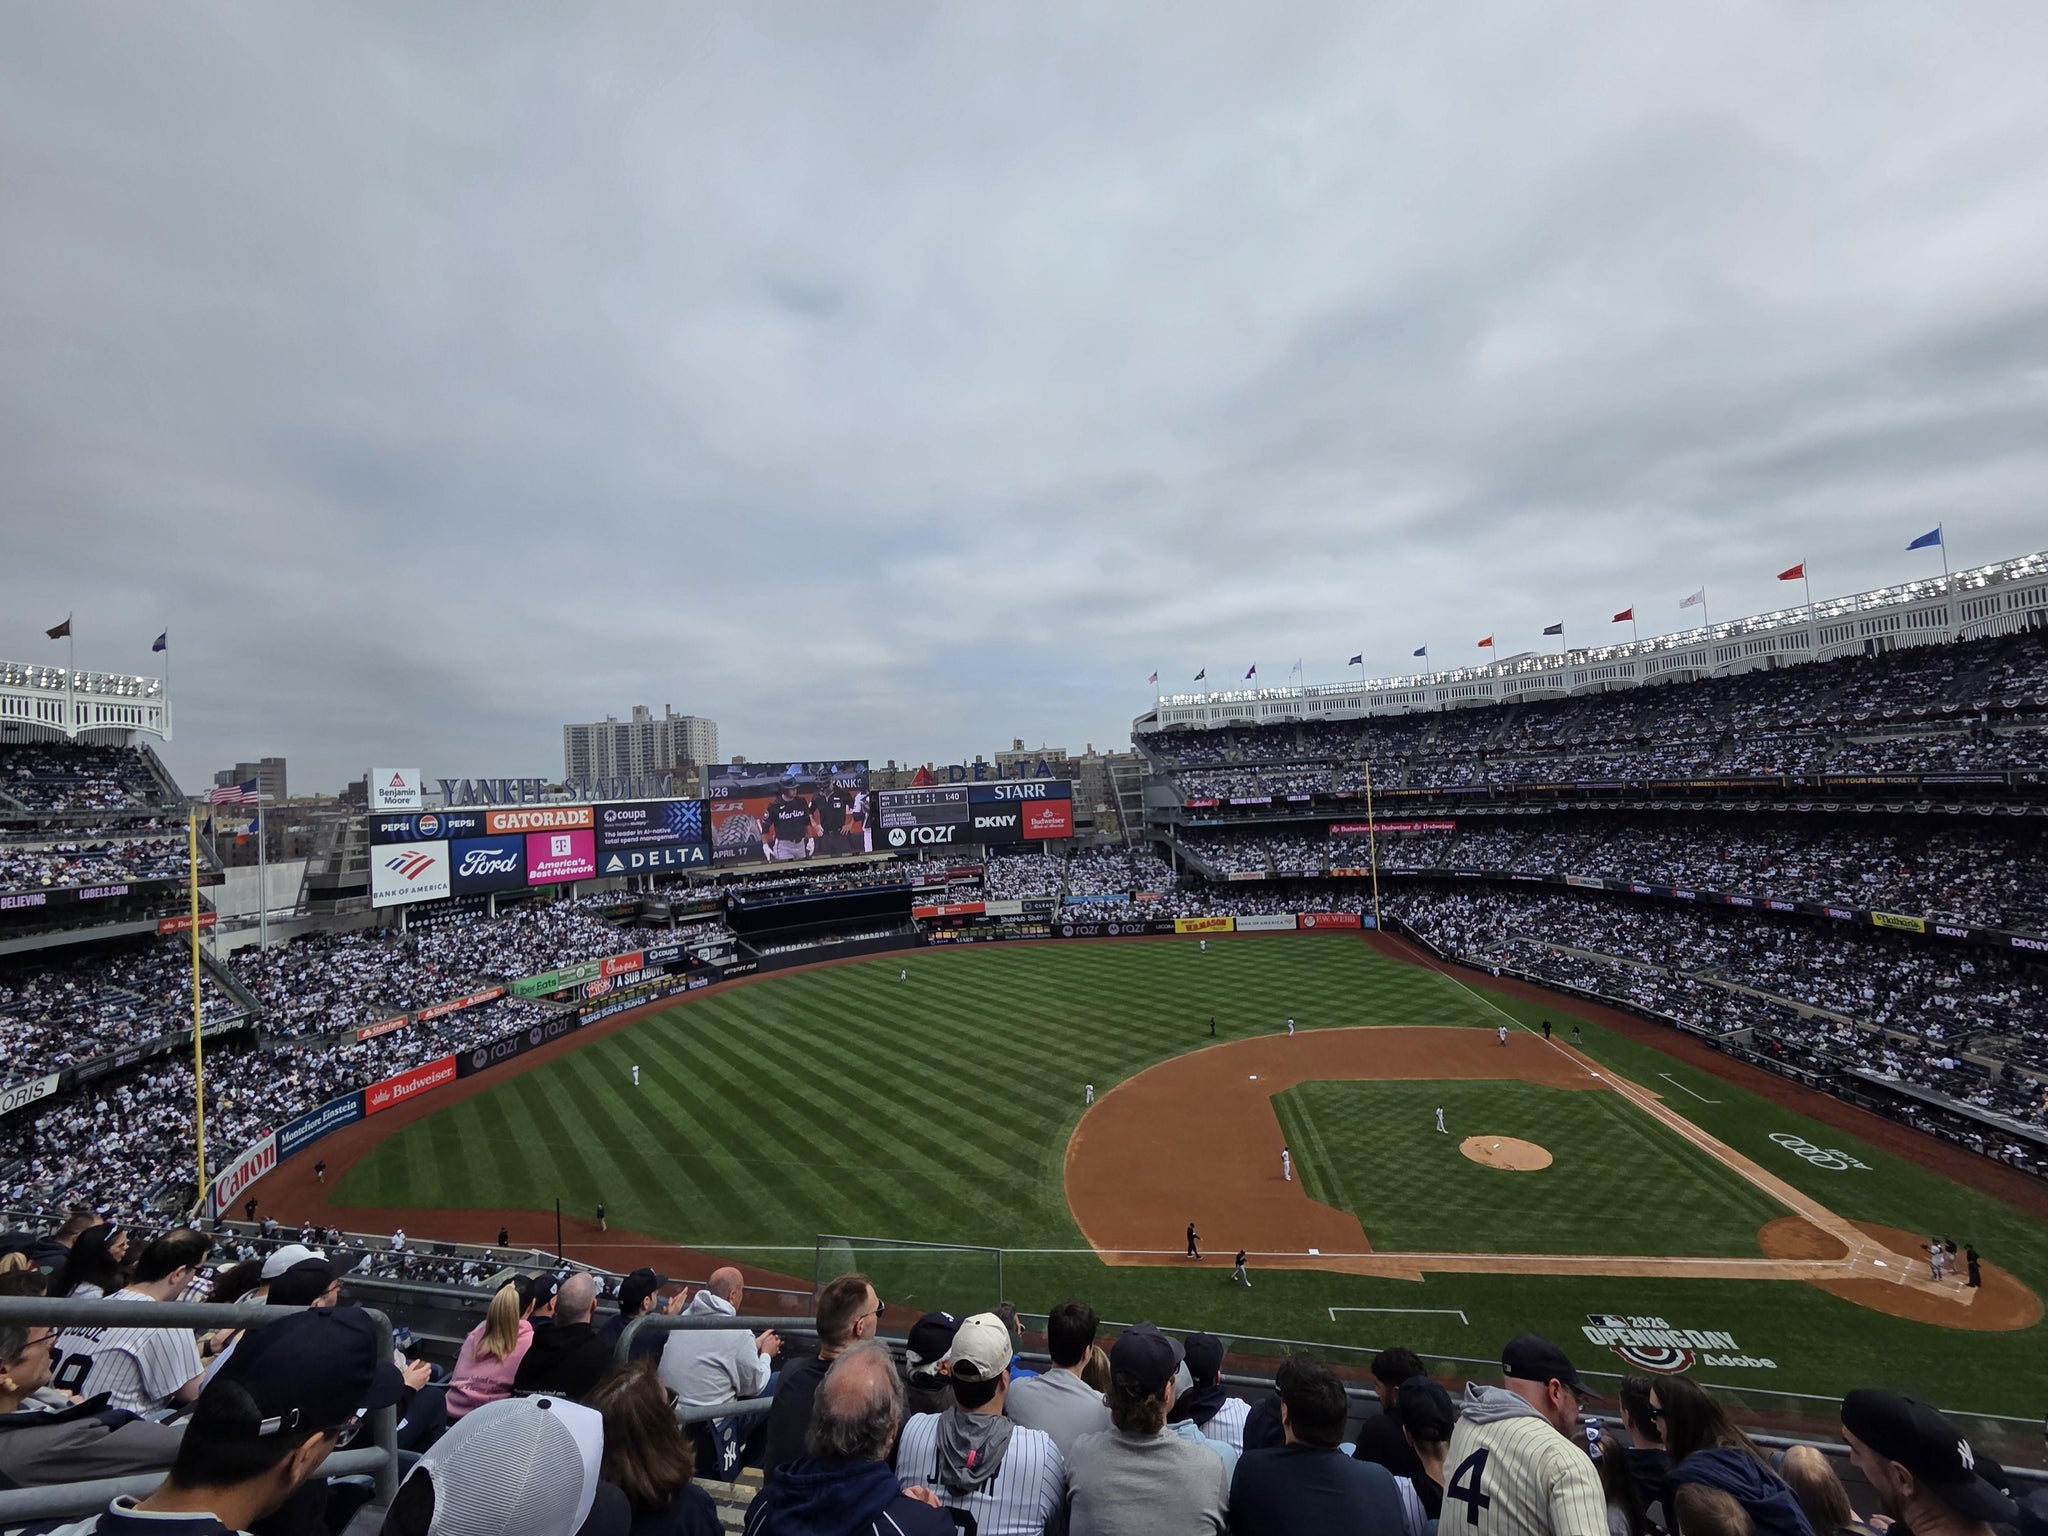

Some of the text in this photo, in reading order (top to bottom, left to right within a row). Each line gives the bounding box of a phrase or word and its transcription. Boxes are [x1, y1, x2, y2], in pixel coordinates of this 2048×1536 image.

[1746, 737, 1815, 748] ASPEN VODKA
[949, 759, 1053, 783] DELTA
[379, 788, 416, 799] Benjamin
[563, 775, 675, 803] STADIUM
[945, 792, 960, 801] 1:40
[994, 784, 1046, 800] STARR
[493, 809, 589, 830] GATORADE
[618, 810, 646, 821] coupa
[974, 815, 1016, 829] DKNY
[1031, 817, 1065, 826] Budweiser
[381, 823, 410, 832] PEPSI
[448, 819, 475, 828] PEPSI
[640, 833, 680, 843] management
[910, 826, 955, 844] razr
[631, 847, 704, 868] DELTA
[713, 847, 748, 859] APRIL 17
[459, 849, 518, 877] Ford
[537, 857, 586, 871] America's
[529, 865, 594, 879] Best Network
[79, 885, 128, 900] LOBELS.COM
[373, 890, 397, 899] BANK
[411, 883, 448, 894] AMERICA
[0, 893, 46, 909] BELIEVING
[1076, 924, 1145, 935] razr razr
[1936, 926, 1969, 938] DKNY
[657, 948, 679, 957] coupa
[617, 966, 665, 987] A SUB ABOVE
[537, 979, 556, 991] Eats
[602, 1006, 623, 1020] StubHub
[624, 998, 646, 1011] StubHub
[218, 1018, 245, 1036] Spring
[544, 1017, 569, 1039] razr
[491, 1037, 519, 1060] razr
[393, 1067, 453, 1099] Budweiser
[2, 1081, 45, 1112] ORIS
[281, 1116, 322, 1146] Montefiore
[322, 1100, 357, 1121] Einstein
[217, 1143, 275, 1208] Canon
[1627, 1316, 1670, 1329] 2026
[1582, 1326, 1740, 1350] OPENING DAY
[1703, 1354, 1778, 1369] Adobe
[1447, 1447, 1490, 1527] 4
